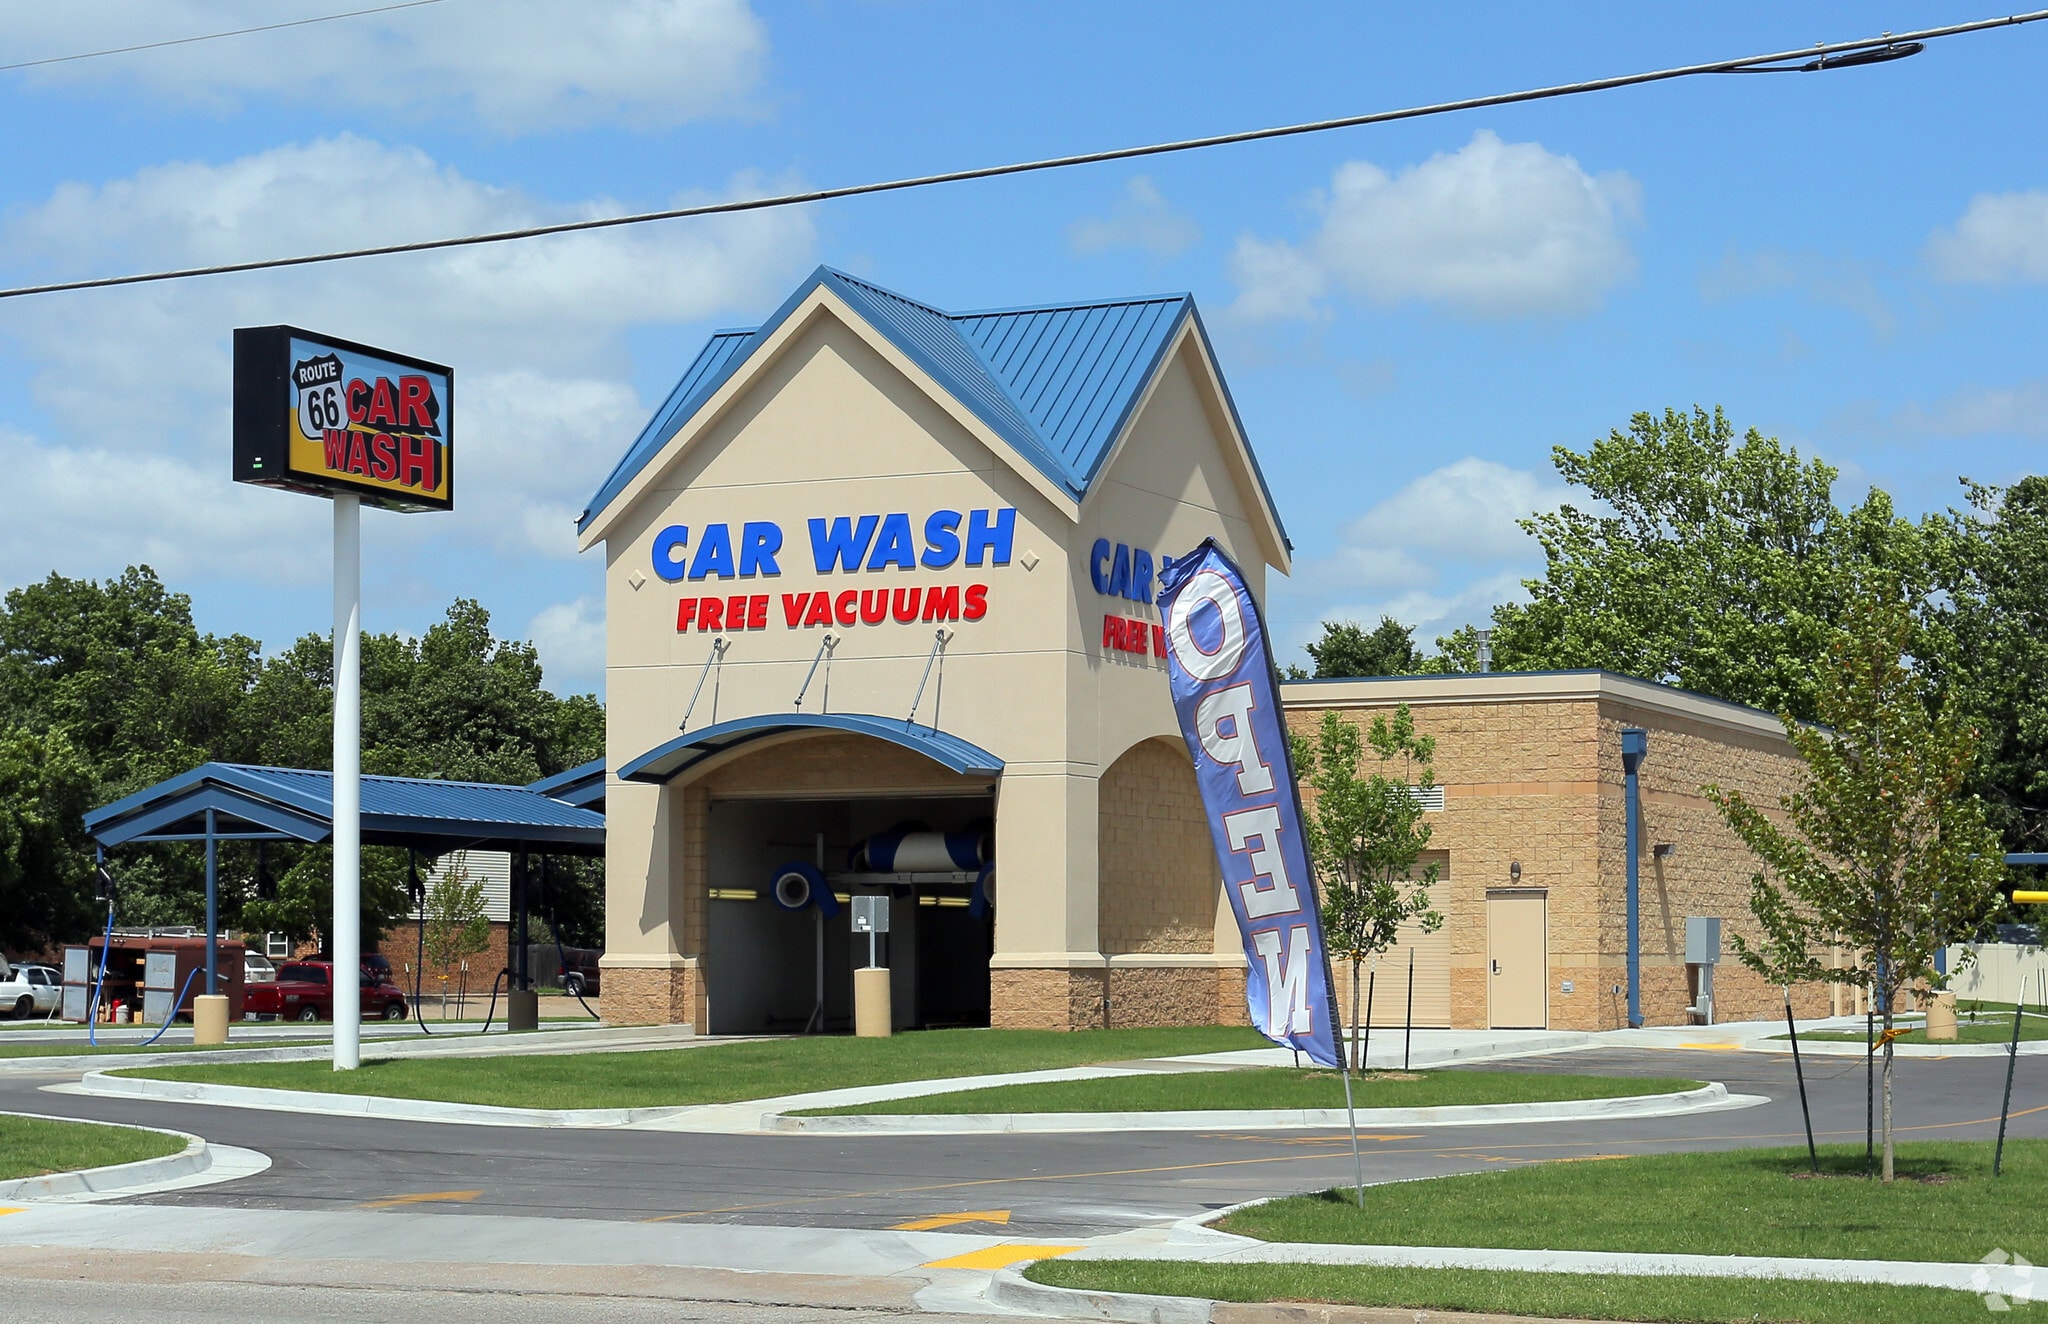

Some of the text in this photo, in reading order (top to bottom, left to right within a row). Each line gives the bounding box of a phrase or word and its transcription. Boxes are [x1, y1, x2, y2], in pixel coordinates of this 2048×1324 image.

[299, 361, 337, 383] ROUTE
[307, 386, 340, 431] 66
[345, 375, 434, 428] CAR
[322, 428, 436, 492] WASH
[651, 507, 1017, 583] CAR WASH
[1090, 537, 1154, 605] CAR
[676, 583, 989, 633] FREE VACUUMS
[1103, 614, 1149, 655] FREE
